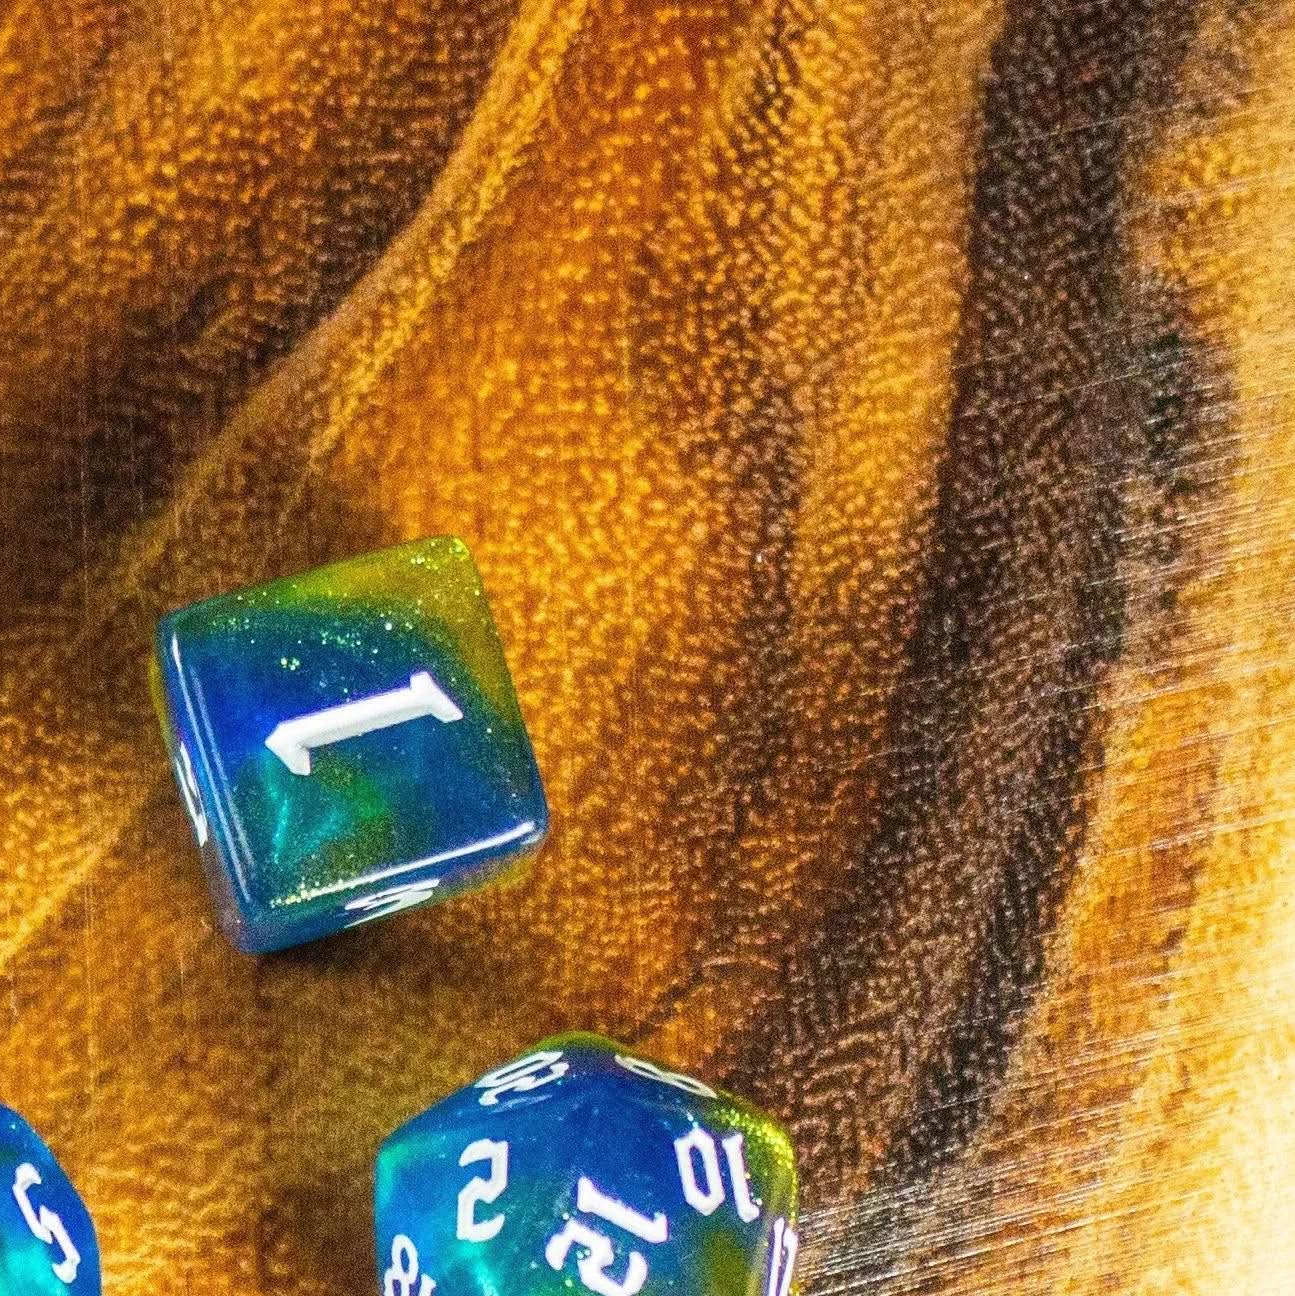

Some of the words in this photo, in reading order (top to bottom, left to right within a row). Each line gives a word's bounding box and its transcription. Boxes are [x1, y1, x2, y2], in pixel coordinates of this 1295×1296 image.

[265, 671, 464, 776] 1
[456, 1138, 509, 1242] 2
[674, 1126, 760, 1223] 10
